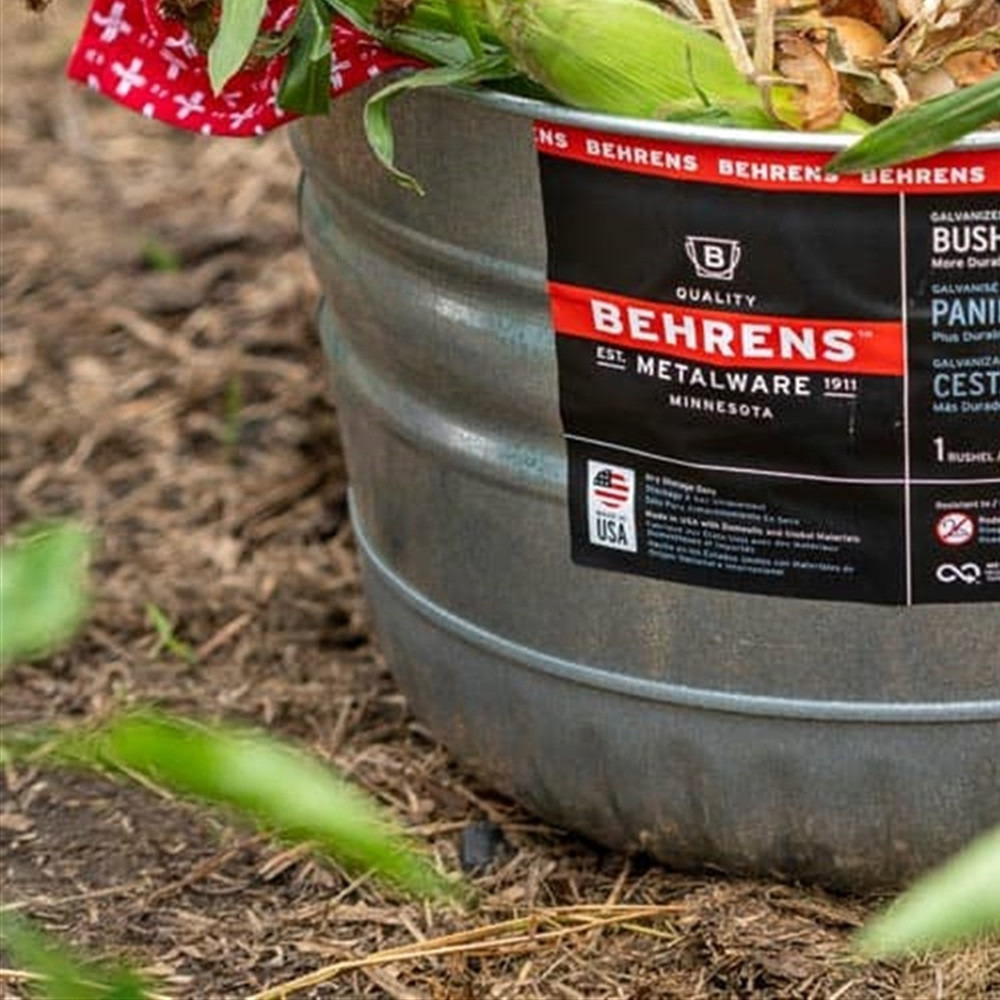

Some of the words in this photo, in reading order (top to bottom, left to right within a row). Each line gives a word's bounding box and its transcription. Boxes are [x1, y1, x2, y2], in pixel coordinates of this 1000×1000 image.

[533, 127, 568, 148] NS
[586, 138, 698, 172] BEHRENS
[861, 166, 985, 184] BEHRENS
[703, 245, 725, 269] B
[931, 257, 964, 269] More
[676, 286, 756, 307] QUALITY
[590, 299, 856, 363] BEHRENS
[597, 346, 627, 363] EST.
[636, 354, 812, 396] METALWARE
[823, 376, 857, 392] 1911
[669, 394, 774, 419] MINNESOTA
[933, 437, 944, 461] 1
[947, 451, 993, 462] BUSHEL
[596, 518, 628, 546] USA
